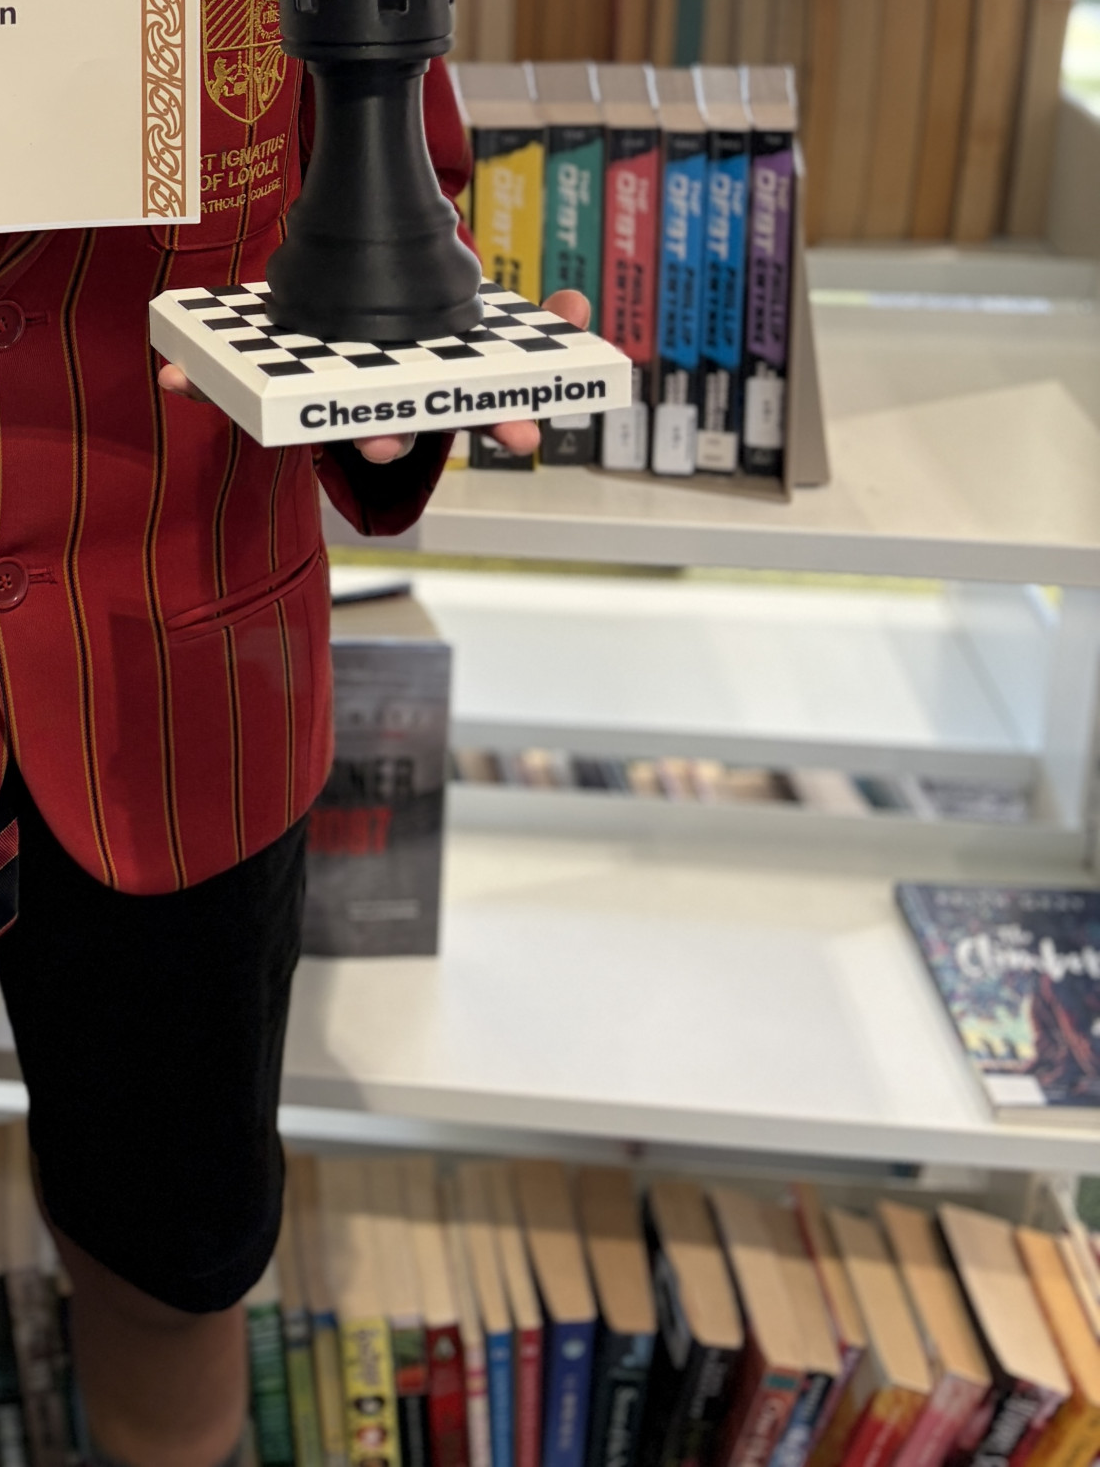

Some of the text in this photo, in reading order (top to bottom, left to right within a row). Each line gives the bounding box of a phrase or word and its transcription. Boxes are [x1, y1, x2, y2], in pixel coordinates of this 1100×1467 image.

[221, 134, 286, 168] IGNATIUS
[200, 155, 280, 192] OF LOYOLA
[200, 177, 282, 214] ATHOLIC COLLEGE
[300, 375, 607, 429] Chess Champion
